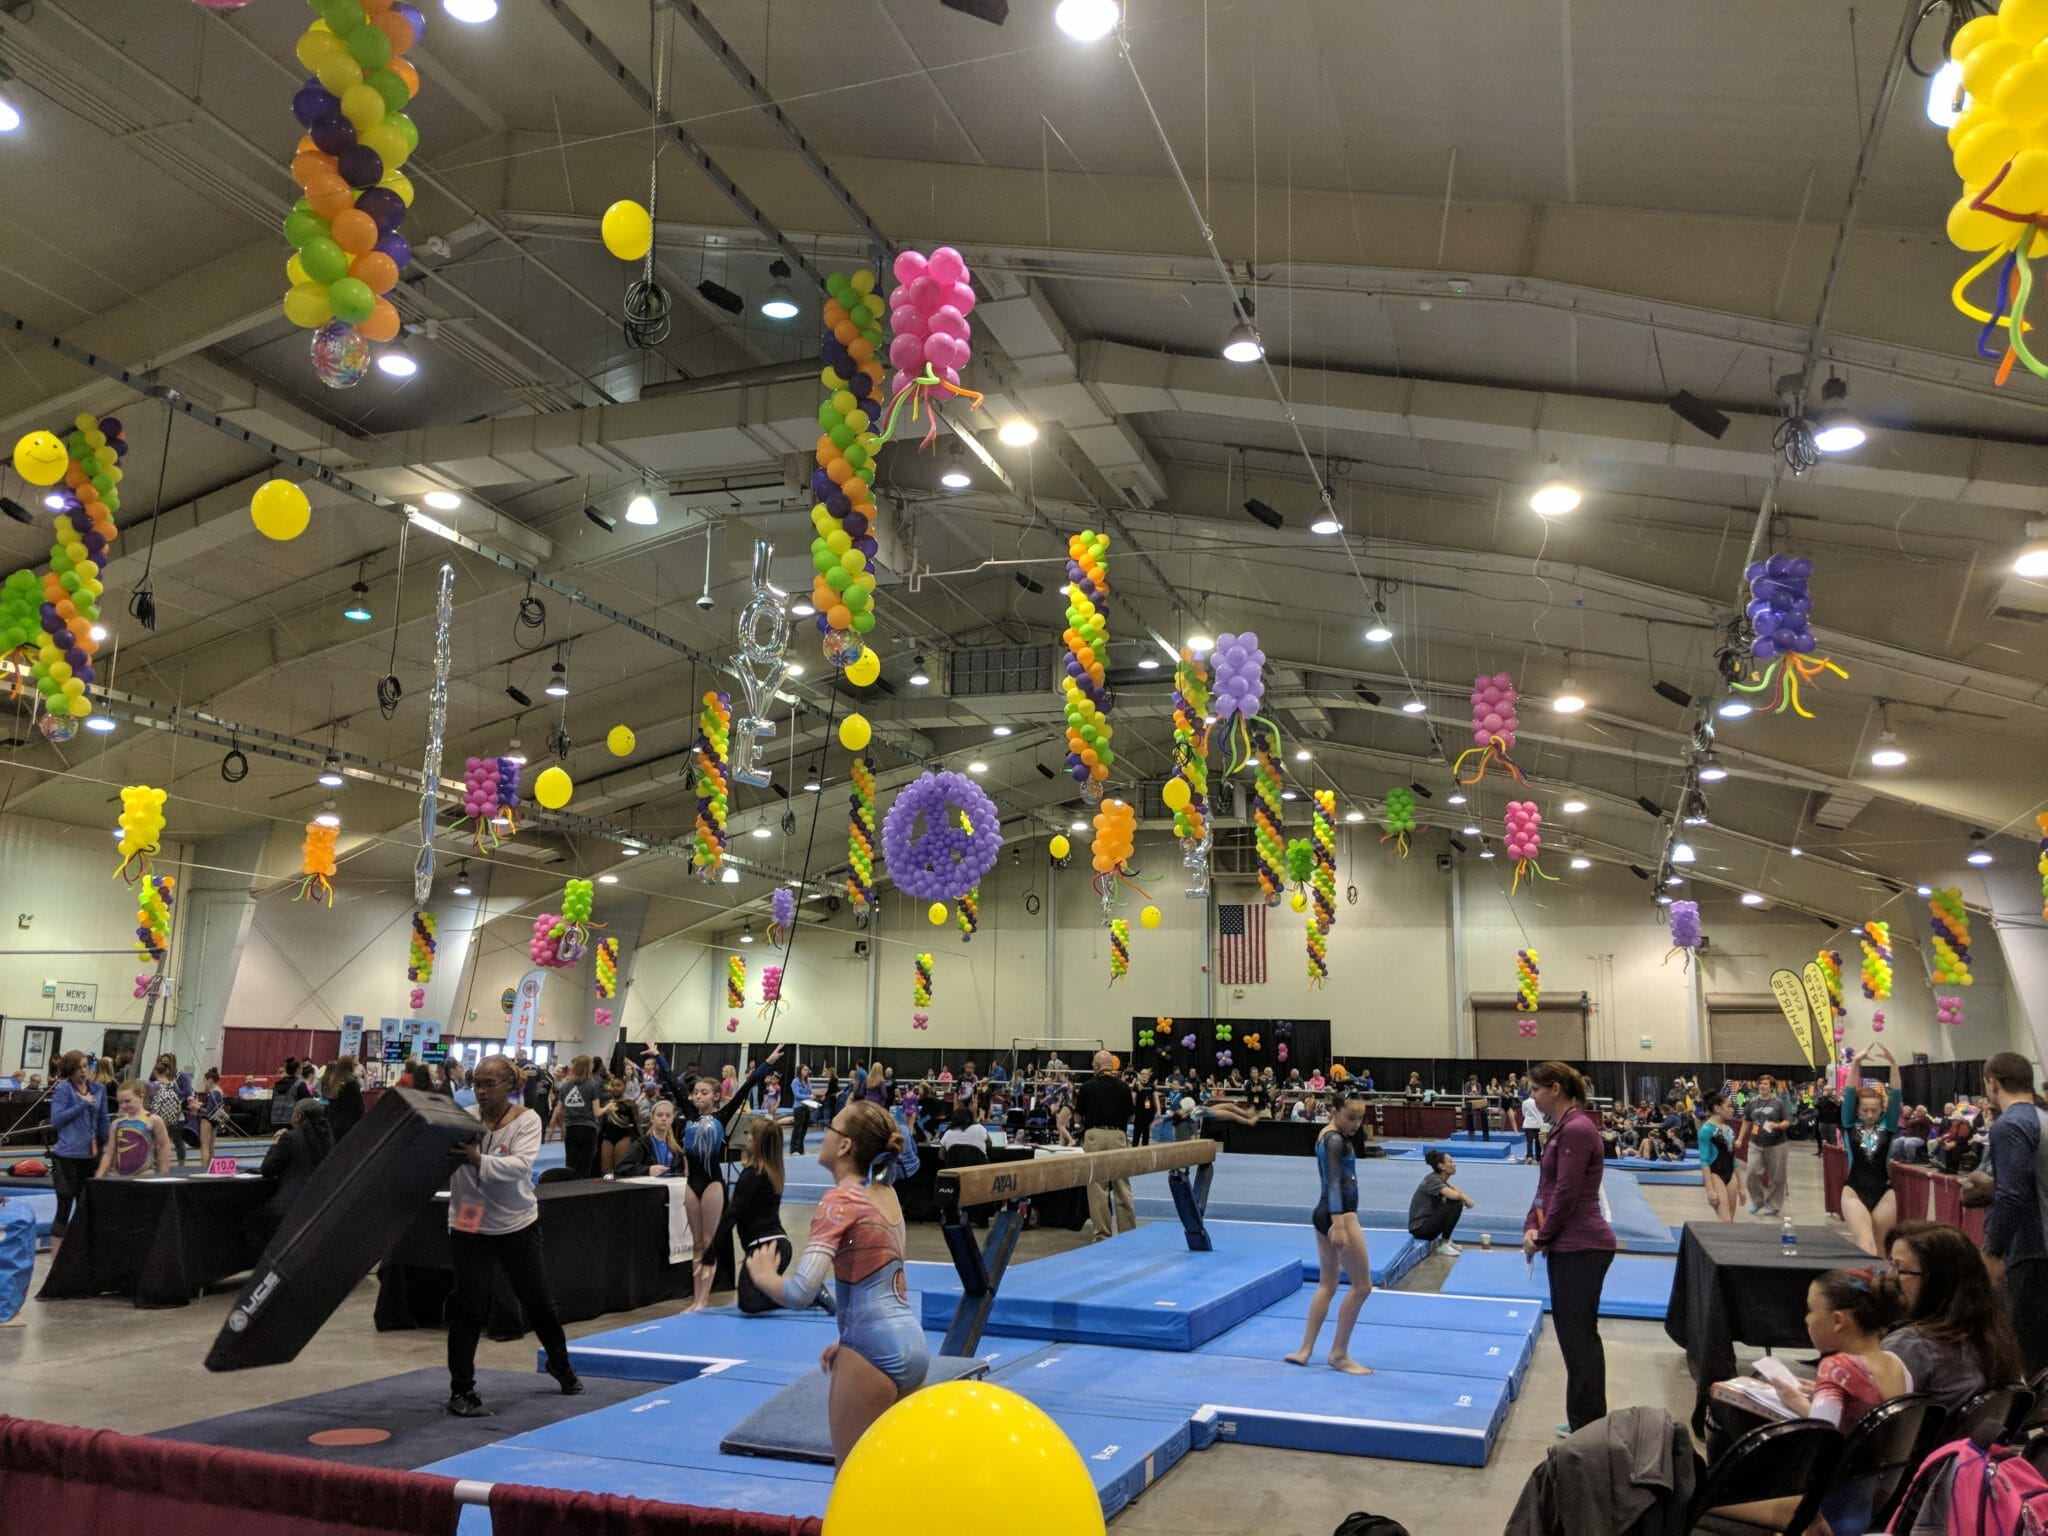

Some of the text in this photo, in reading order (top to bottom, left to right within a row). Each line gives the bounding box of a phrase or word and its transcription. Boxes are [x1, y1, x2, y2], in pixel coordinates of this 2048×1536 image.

[729, 538, 790, 789] LOVE
[65, 989, 87, 999] MEN'S
[55, 1002, 93, 1013] RESTROOM
[515, 1001, 532, 1050] PHOT
[216, 1161, 236, 1170] 10.0
